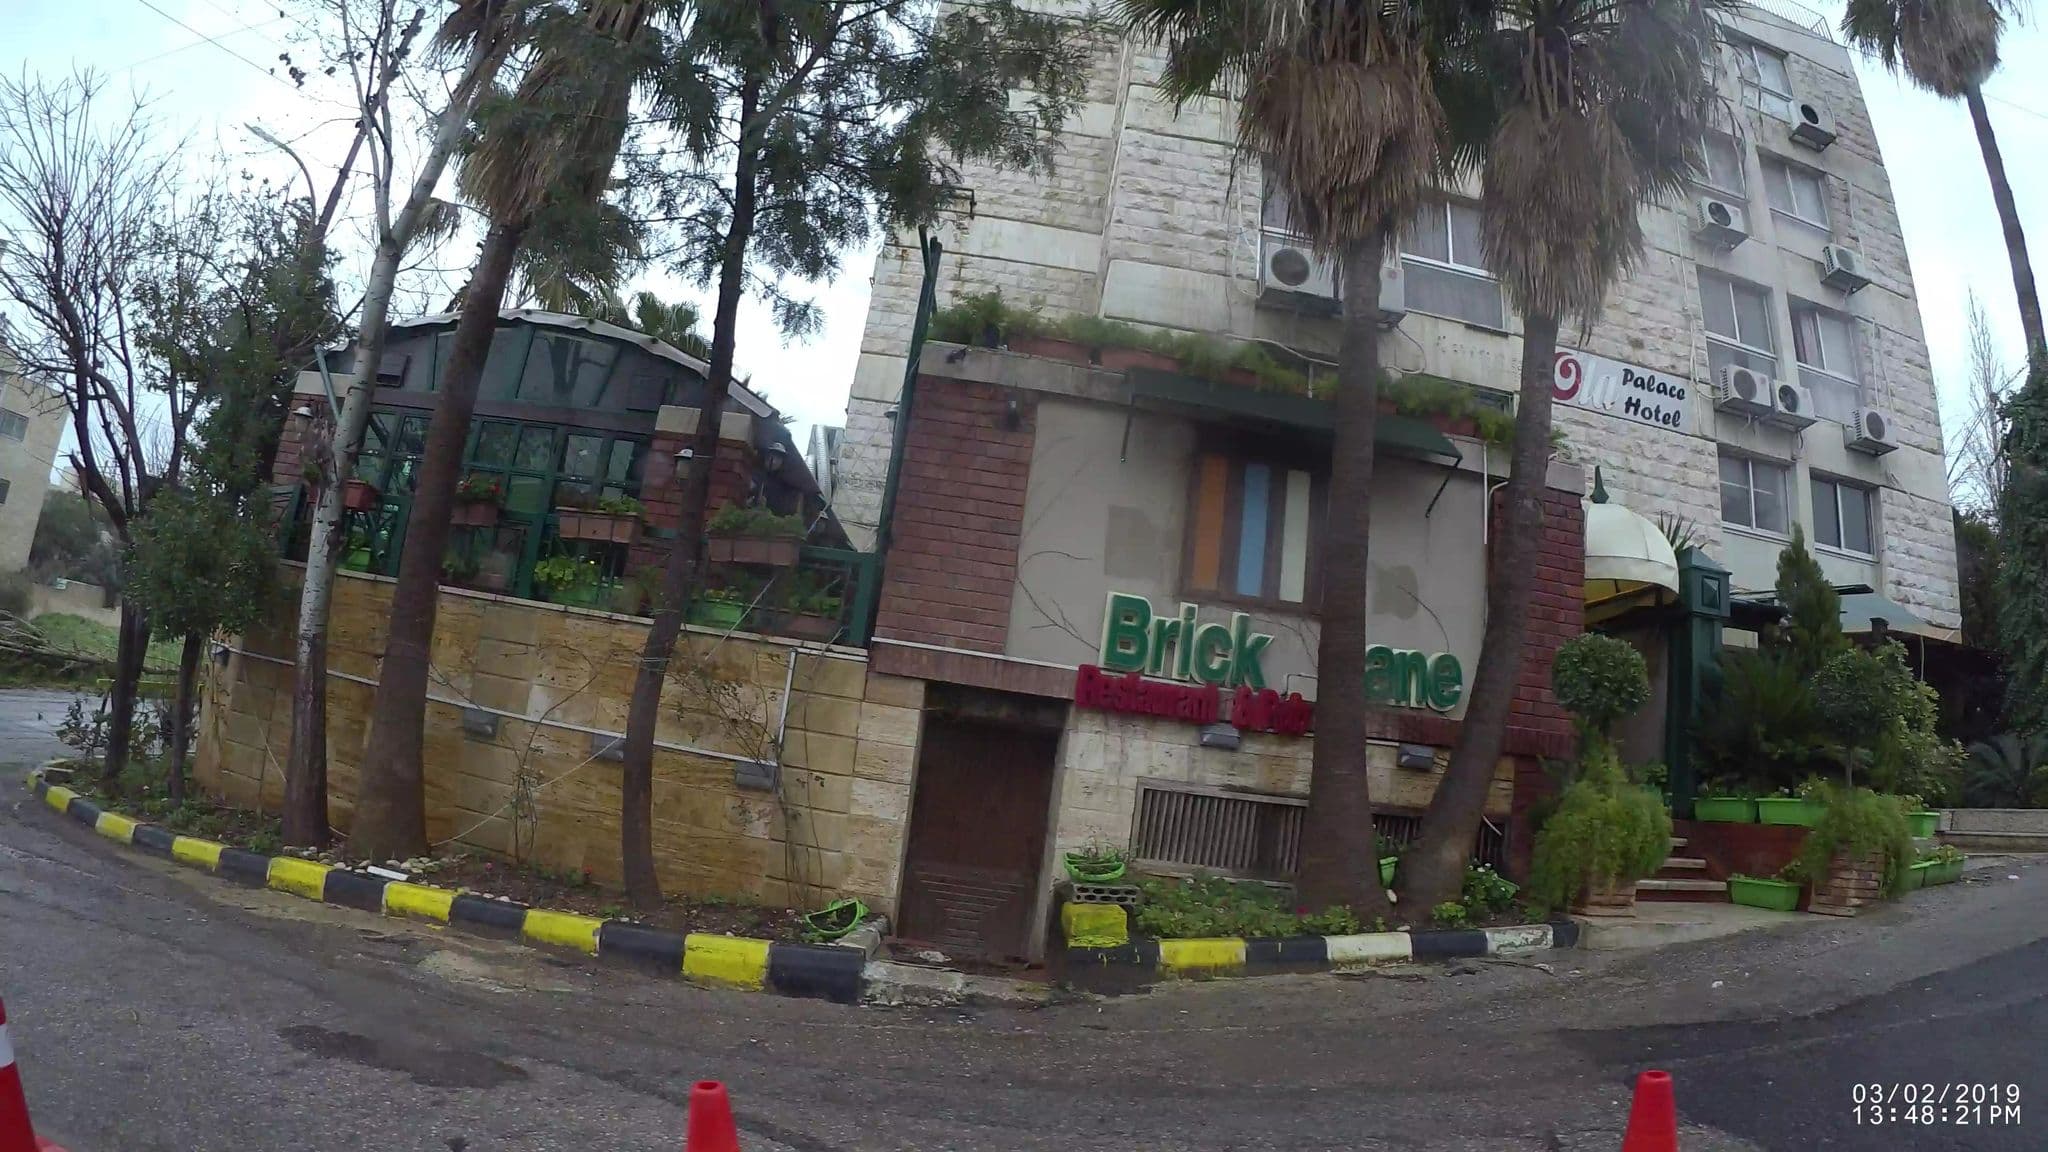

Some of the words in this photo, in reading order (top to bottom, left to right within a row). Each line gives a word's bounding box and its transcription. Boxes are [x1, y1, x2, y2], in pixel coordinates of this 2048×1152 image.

[1622, 367, 1686, 401] Palace
[1624, 396, 1682, 428] Hotel
[1100, 591, 1275, 689] Brick
[1364, 643, 1463, 712] ane
[1075, 663, 1218, 725] Restaurant
